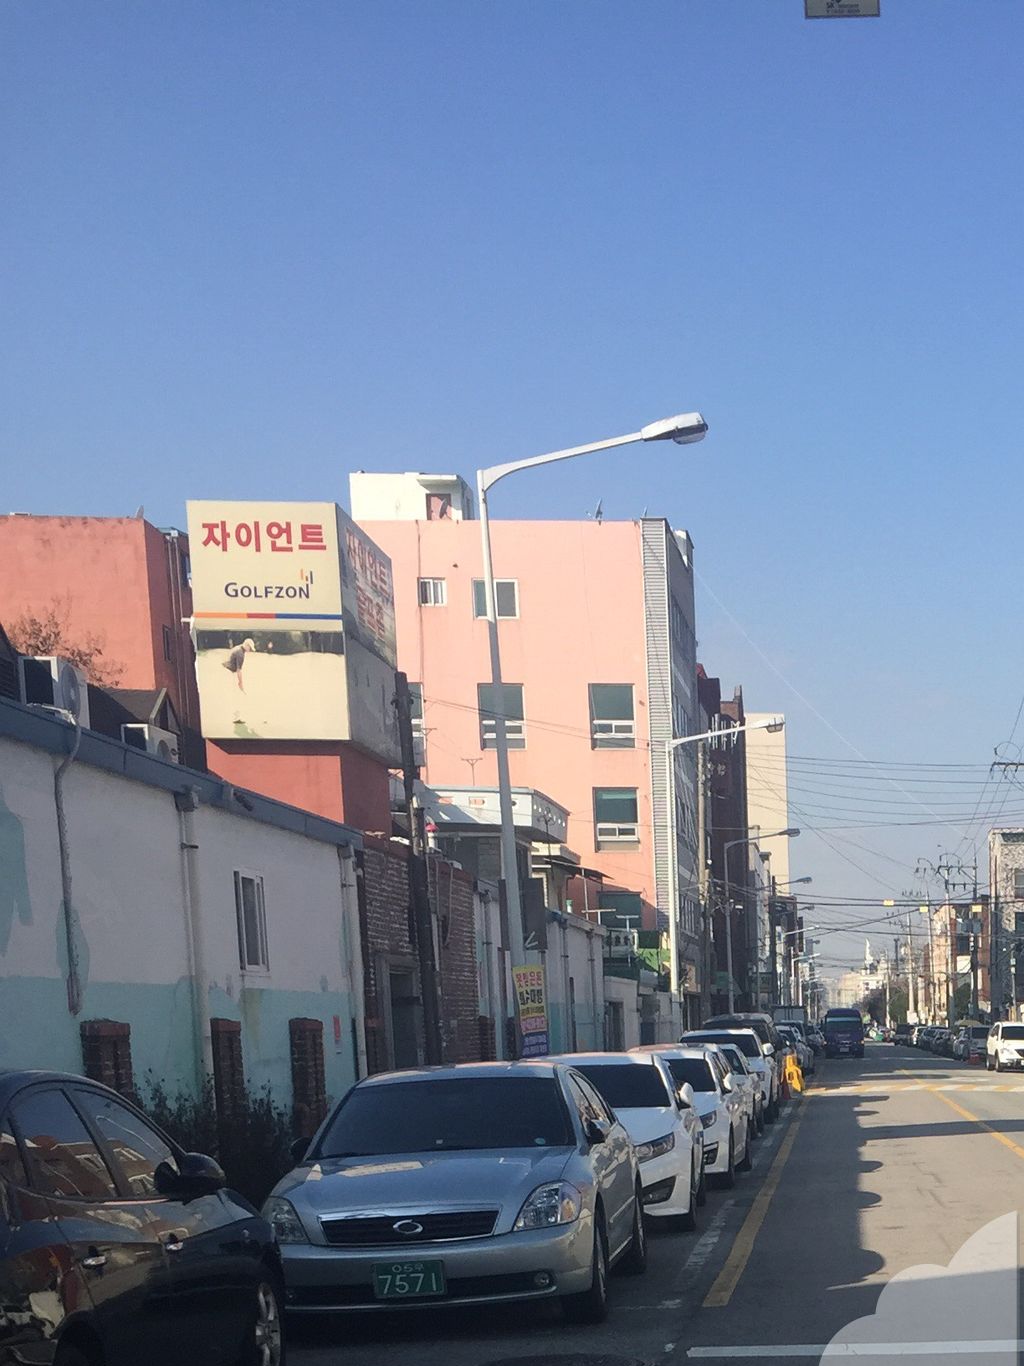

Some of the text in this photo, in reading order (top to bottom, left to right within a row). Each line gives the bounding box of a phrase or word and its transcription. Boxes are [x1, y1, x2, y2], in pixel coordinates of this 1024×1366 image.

[202, 520, 327, 553] 자이언트
[224, 581, 311, 599] GOLFZON
[378, 1273, 437, 1295] 7571
